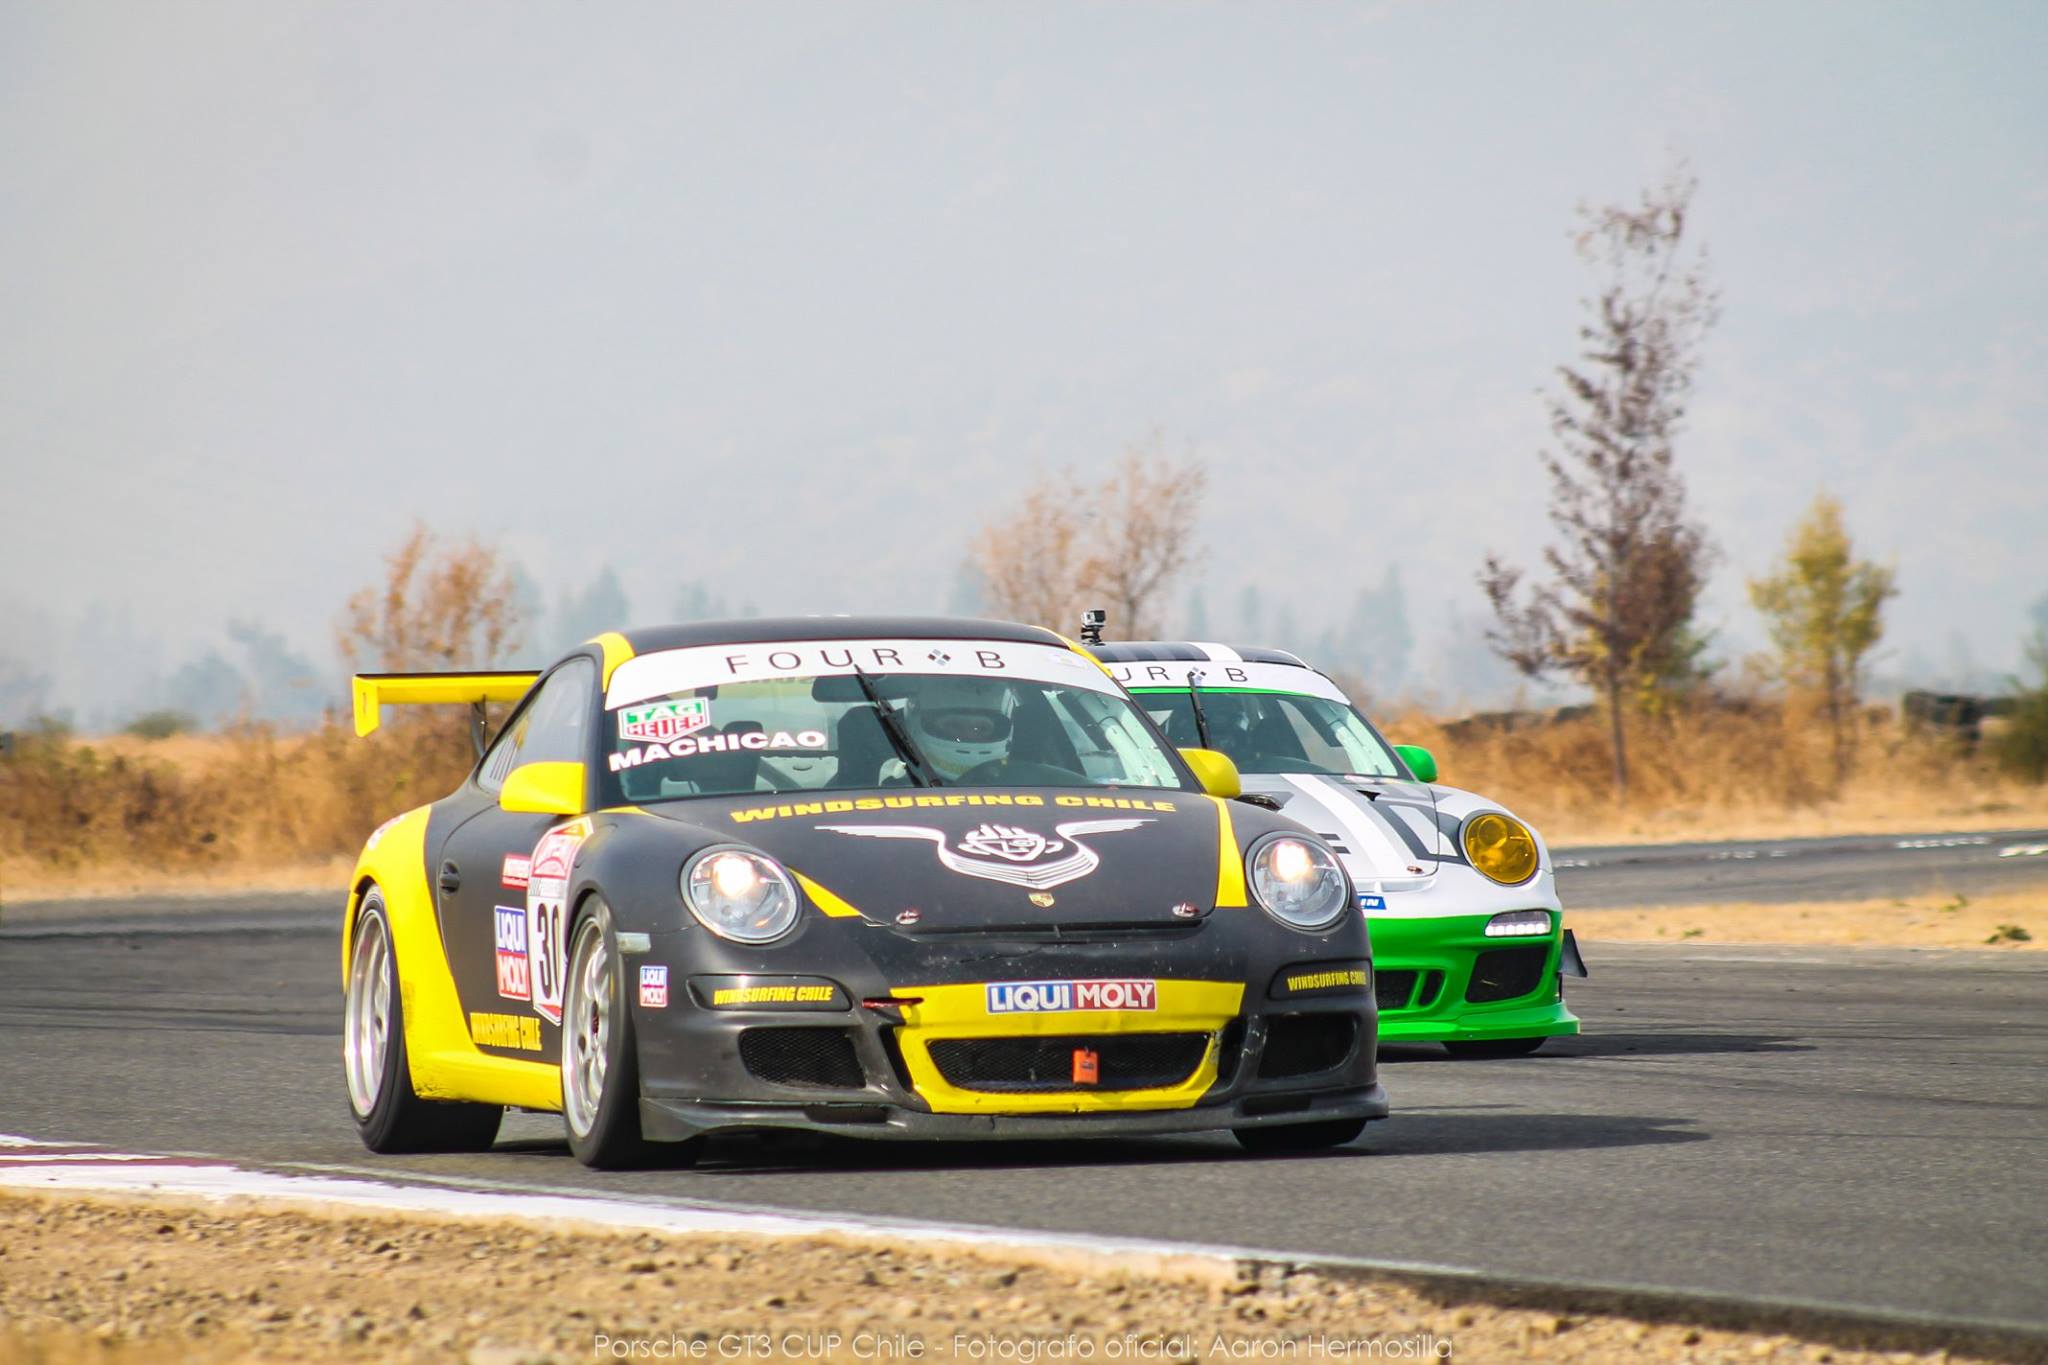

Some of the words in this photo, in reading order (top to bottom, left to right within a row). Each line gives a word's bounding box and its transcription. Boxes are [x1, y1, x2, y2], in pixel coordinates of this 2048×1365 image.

[725, 648, 904, 675] FOUR
[975, 650, 1006, 669] B
[1224, 667, 1249, 682] B
[627, 702, 701, 723] TAG
[627, 716, 704, 737] HEUER
[608, 731, 827, 772] MACHICAO
[730, 795, 1044, 823] WINDSURFING
[1055, 795, 1177, 812] CHILE
[495, 911, 527, 952] LIQUI
[498, 954, 529, 997] MOLY
[641, 968, 665, 985] LIQUI
[1287, 971, 1349, 992] WINDSURFING
[641, 986, 665, 1003] MOLY
[713, 987, 796, 1005] WINDSURFING
[796, 985, 834, 1001] CHILE
[990, 985, 1070, 1011] LIQUI
[1077, 983, 1153, 1008] MOLY
